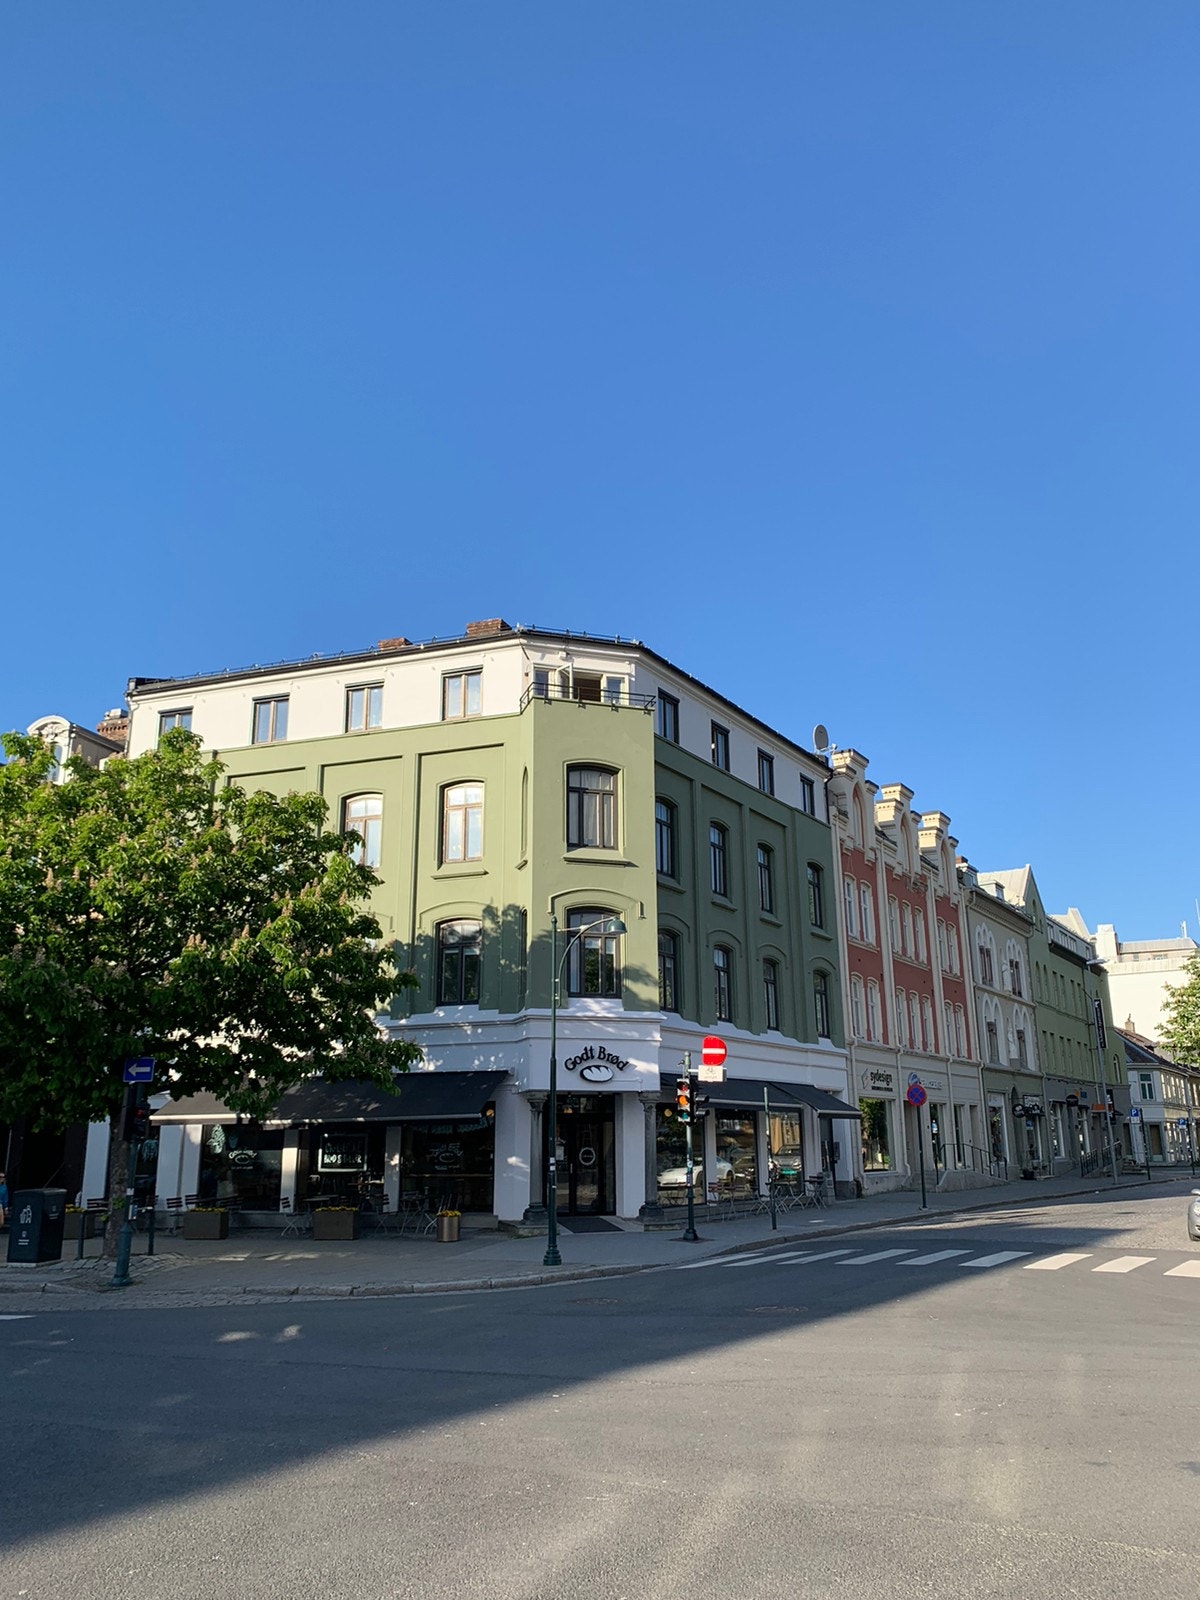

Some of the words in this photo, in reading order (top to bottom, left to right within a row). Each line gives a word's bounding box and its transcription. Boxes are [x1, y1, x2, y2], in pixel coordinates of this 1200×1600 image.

[564, 1045, 595, 1071] Godt
[597, 1045, 630, 1071] Brød
[870, 1069, 892, 1086] sydesign
